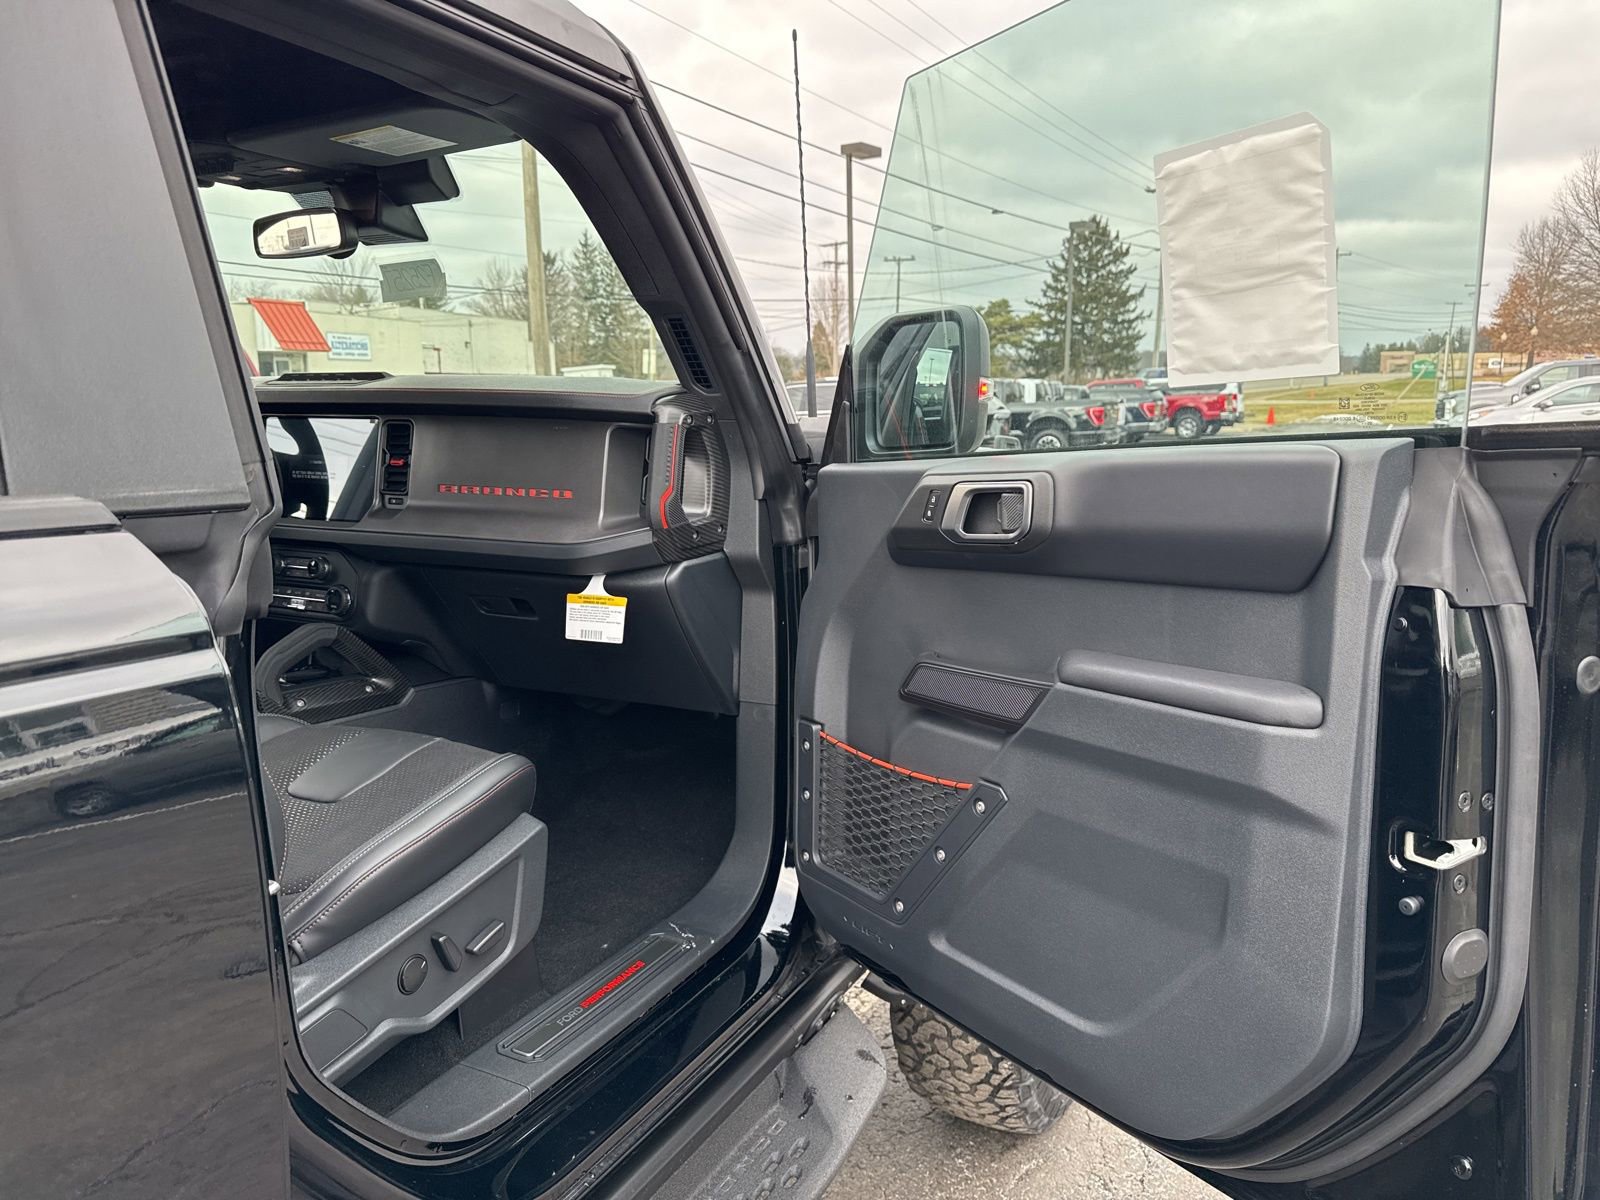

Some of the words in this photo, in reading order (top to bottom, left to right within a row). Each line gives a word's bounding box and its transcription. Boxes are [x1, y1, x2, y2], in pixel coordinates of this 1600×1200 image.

[438, 483, 574, 499] BRONCO
[556, 1006, 584, 1026] FORD
[579, 959, 646, 1008] PERFORMANCE
